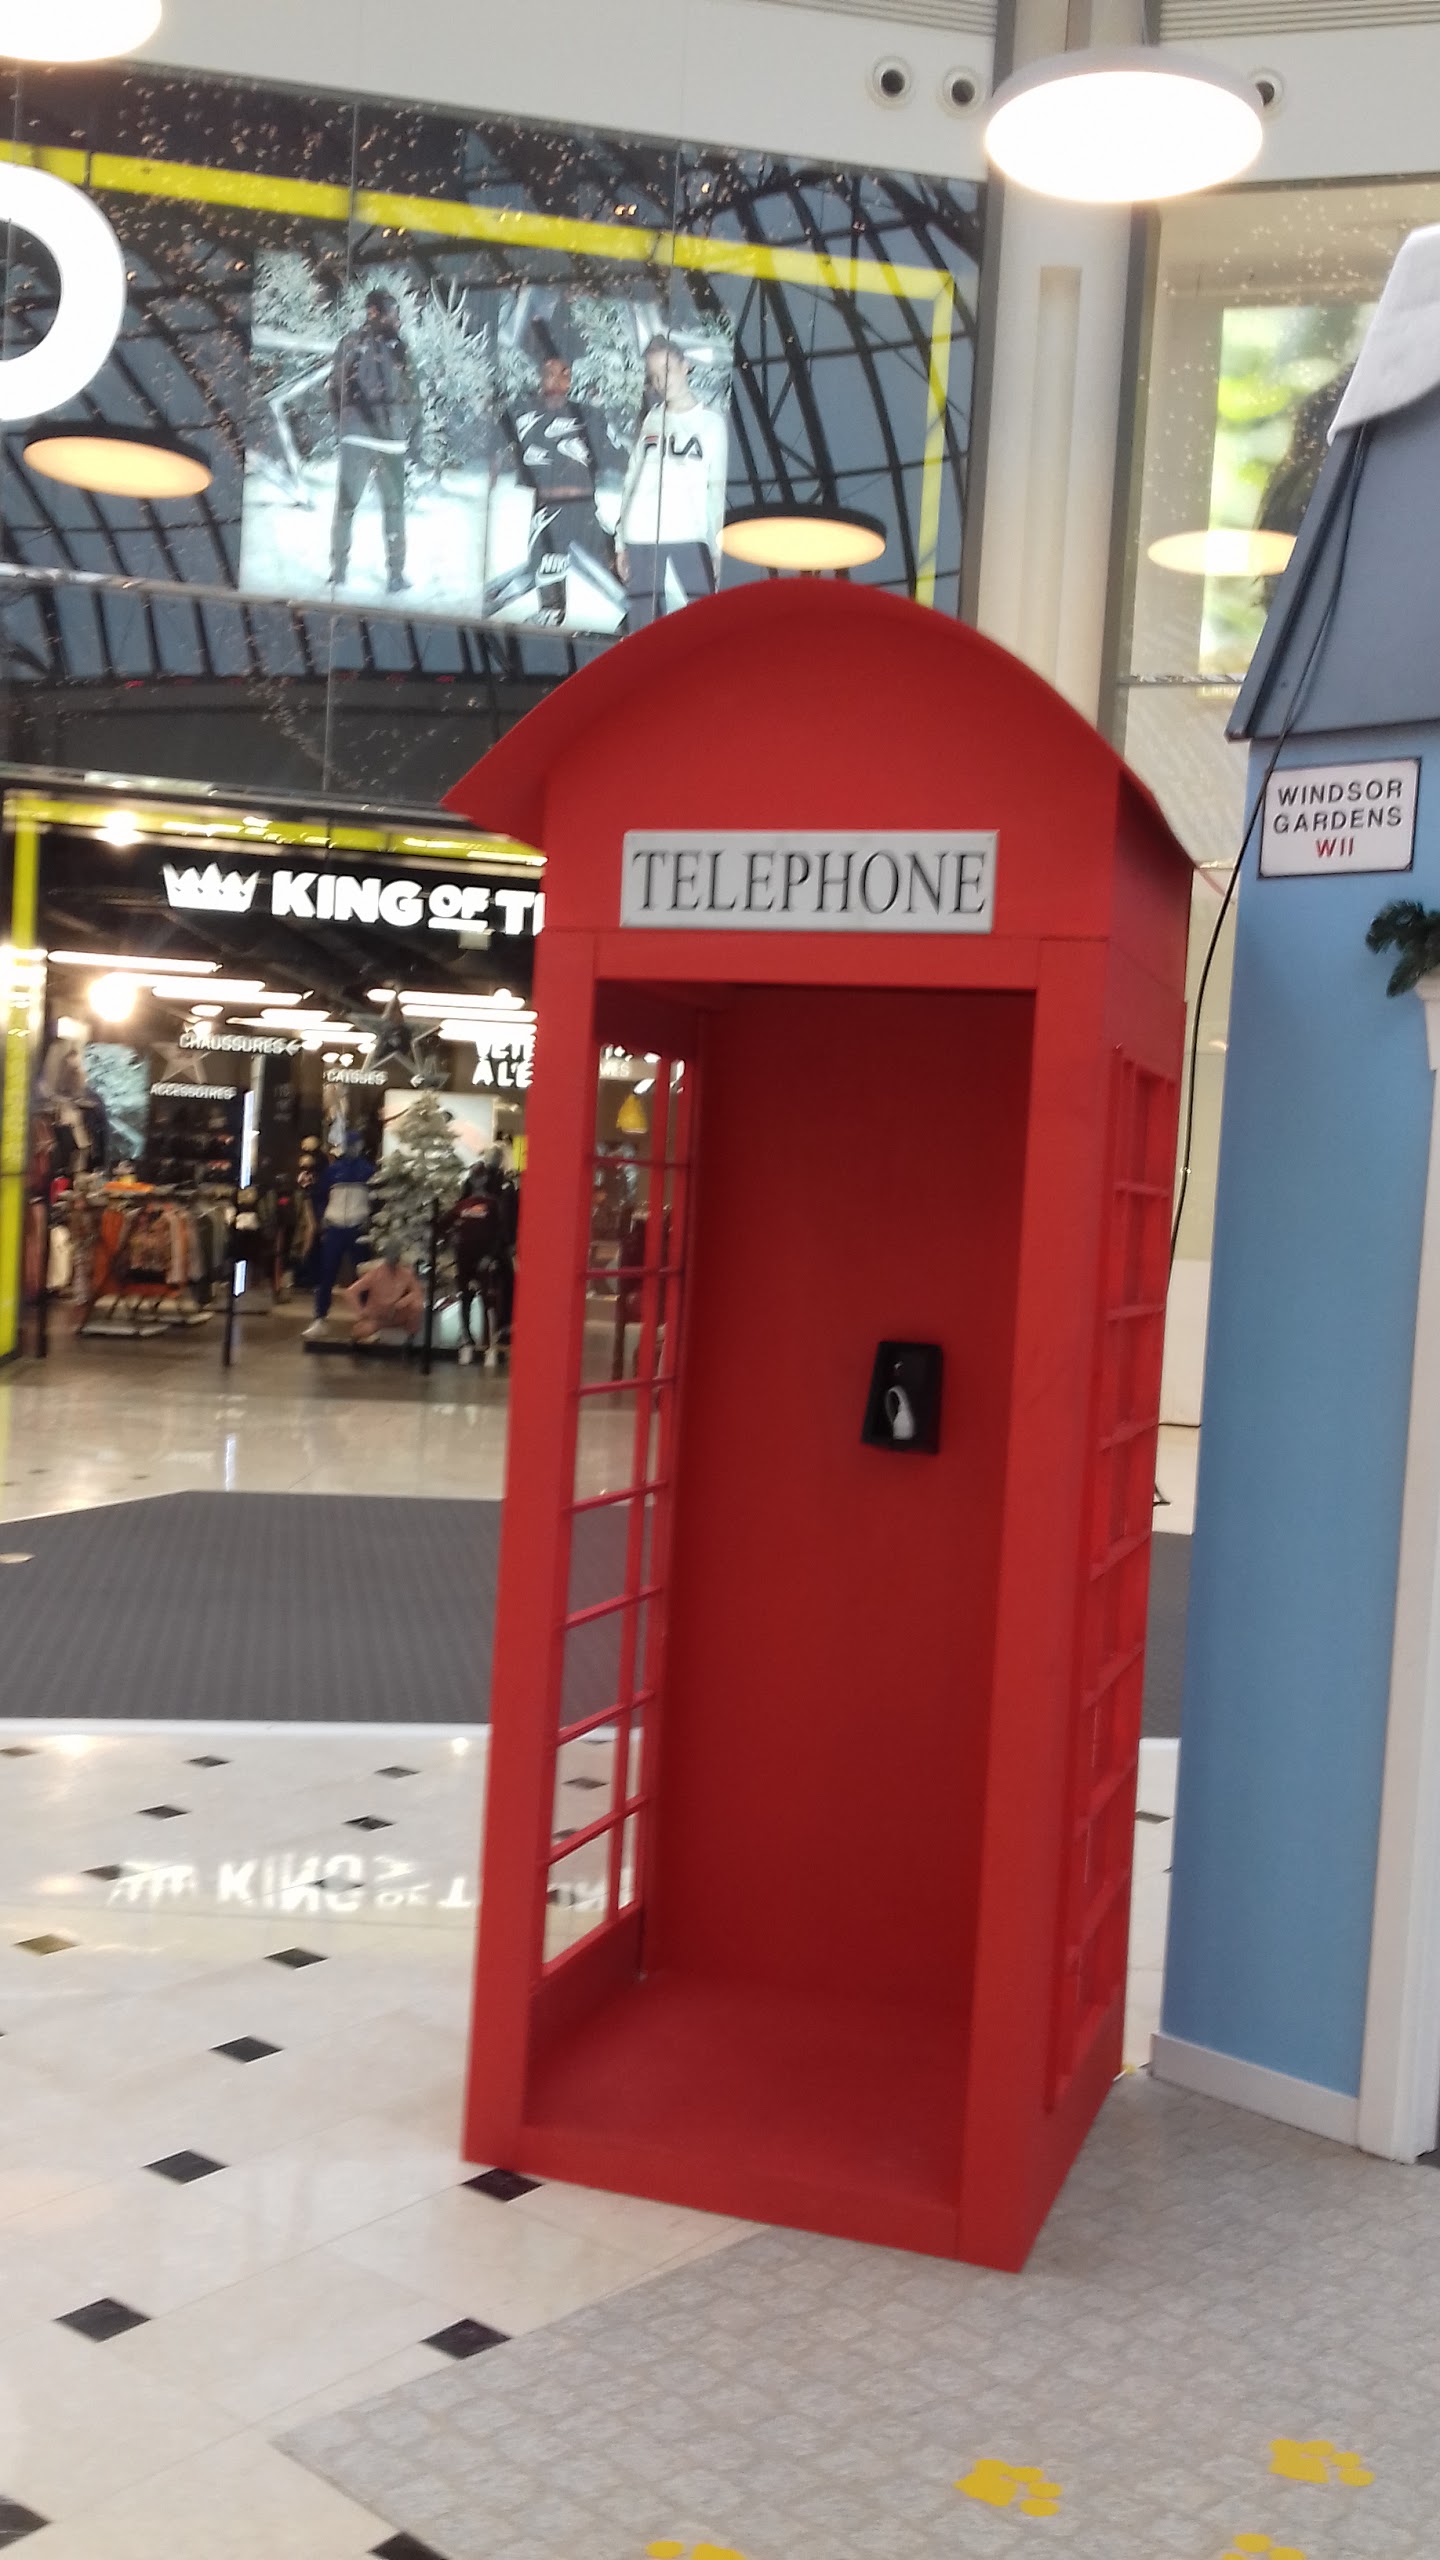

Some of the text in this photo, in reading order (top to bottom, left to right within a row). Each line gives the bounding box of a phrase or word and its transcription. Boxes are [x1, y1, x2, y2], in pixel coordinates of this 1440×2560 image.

[1278, 779, 1403, 806] WINDSOR
[1273, 806, 1402, 834] GARDENS
[271, 869, 425, 927] KING
[428, 883, 491, 931] OF
[632, 849, 987, 915] TELEPHONE
